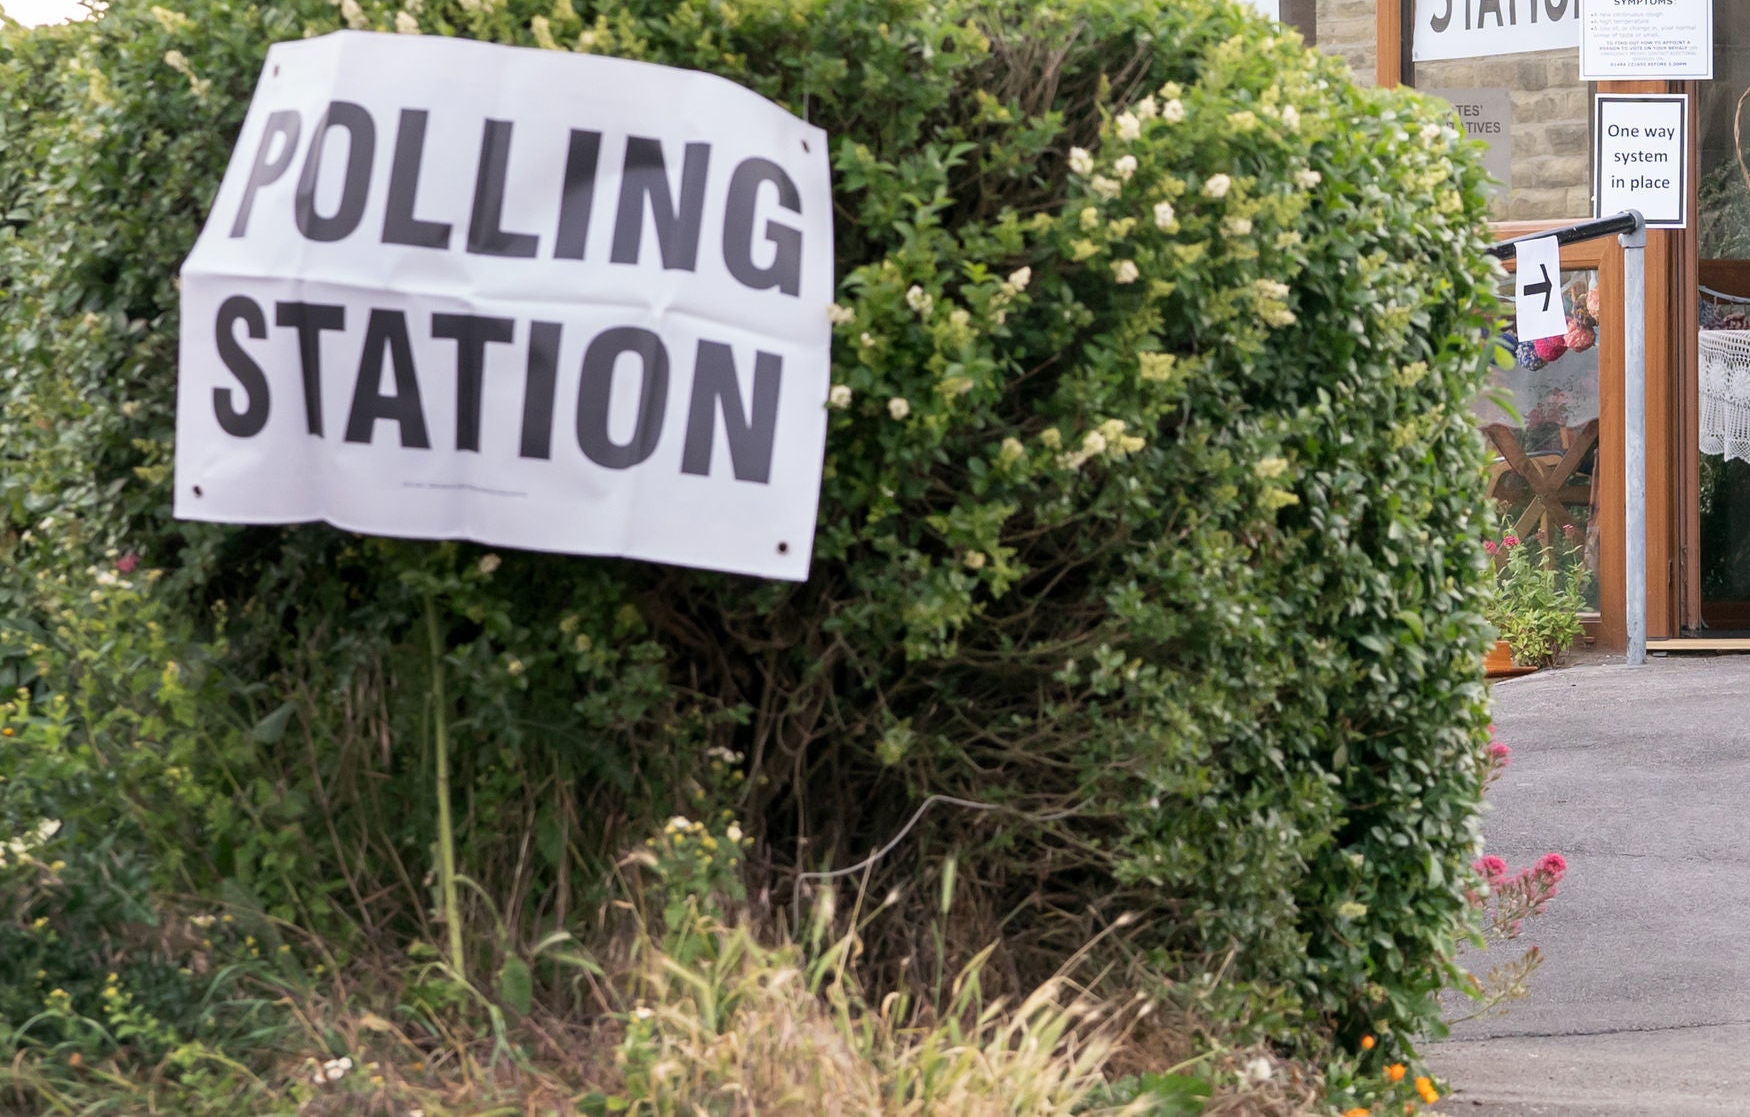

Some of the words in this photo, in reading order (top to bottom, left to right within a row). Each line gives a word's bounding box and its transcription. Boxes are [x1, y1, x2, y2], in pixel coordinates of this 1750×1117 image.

[1608, 124, 1639, 137] One
[1645, 127, 1675, 140] way
[1614, 150, 1668, 165] system
[1611, 175, 1625, 188] in
[1630, 175, 1670, 191] place
[229, 100, 804, 297] POLLING
[212, 294, 784, 485] STATION
